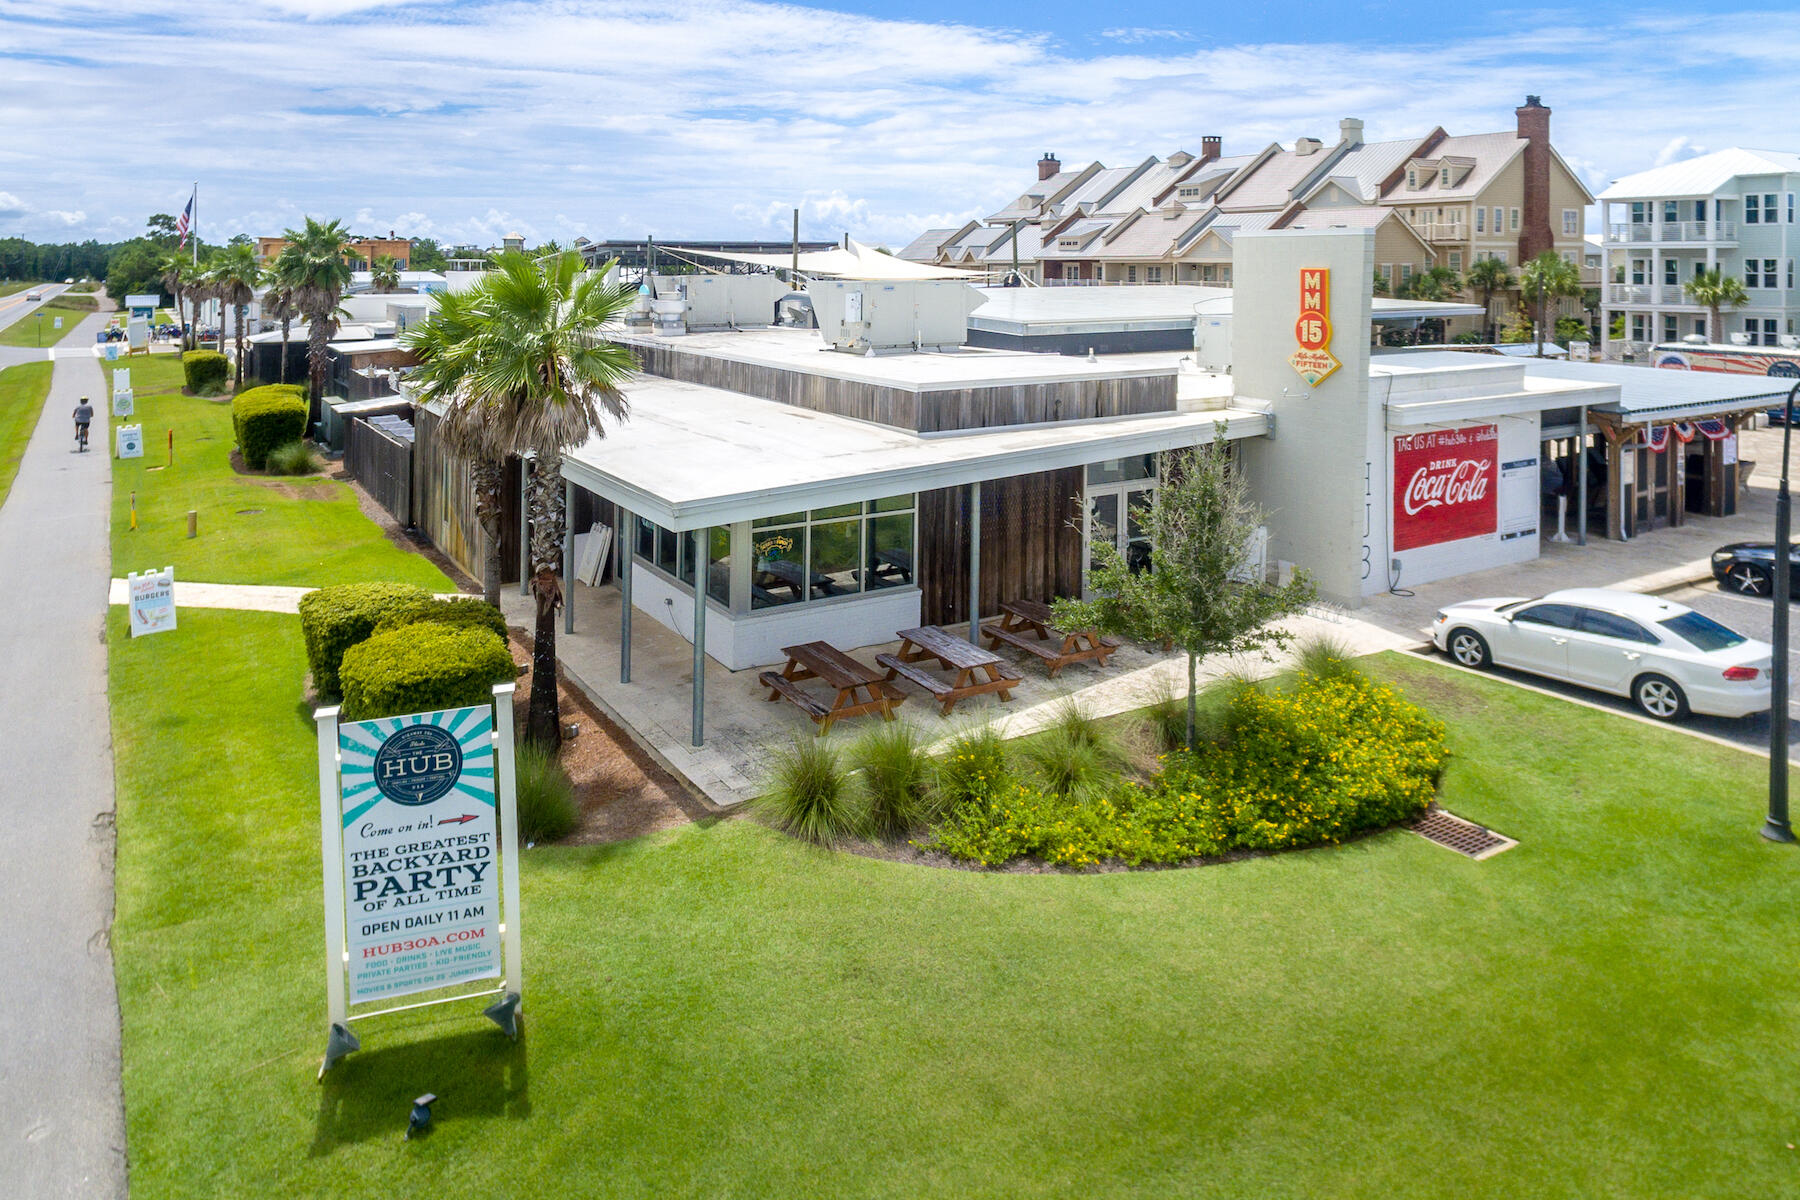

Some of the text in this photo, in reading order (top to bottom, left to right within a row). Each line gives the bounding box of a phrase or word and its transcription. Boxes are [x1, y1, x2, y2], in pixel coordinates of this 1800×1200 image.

[1299, 319, 1323, 343] 15
[1296, 360, 1328, 369] FIFTEEN
[1414, 435, 1425, 449] US
[1426, 433, 1437, 449] AT
[1429, 458, 1457, 471] DRINK
[1404, 457, 1492, 516] Coca-Cola
[383, 752, 453, 778] HUB
[360, 815, 434, 839] Come on in!
[350, 832, 491, 862] THE GREATEST
[351, 845, 491, 879] BACKYARD
[353, 861, 491, 902] PARTY
[363, 884, 482, 912] OF ALL TIME
[361, 905, 485, 937] OPEN DAILY 11 AM
[362, 927, 486, 959] HUB30A.COM
[365, 942, 481, 969] FOOD DRINKS LIVE MUSIC
[357, 949, 492, 979] PRIVATE PARTIES KID-FRIENDLY
[356, 984, 385, 995] MOVIES
[394, 976, 422, 988] SPORTS
